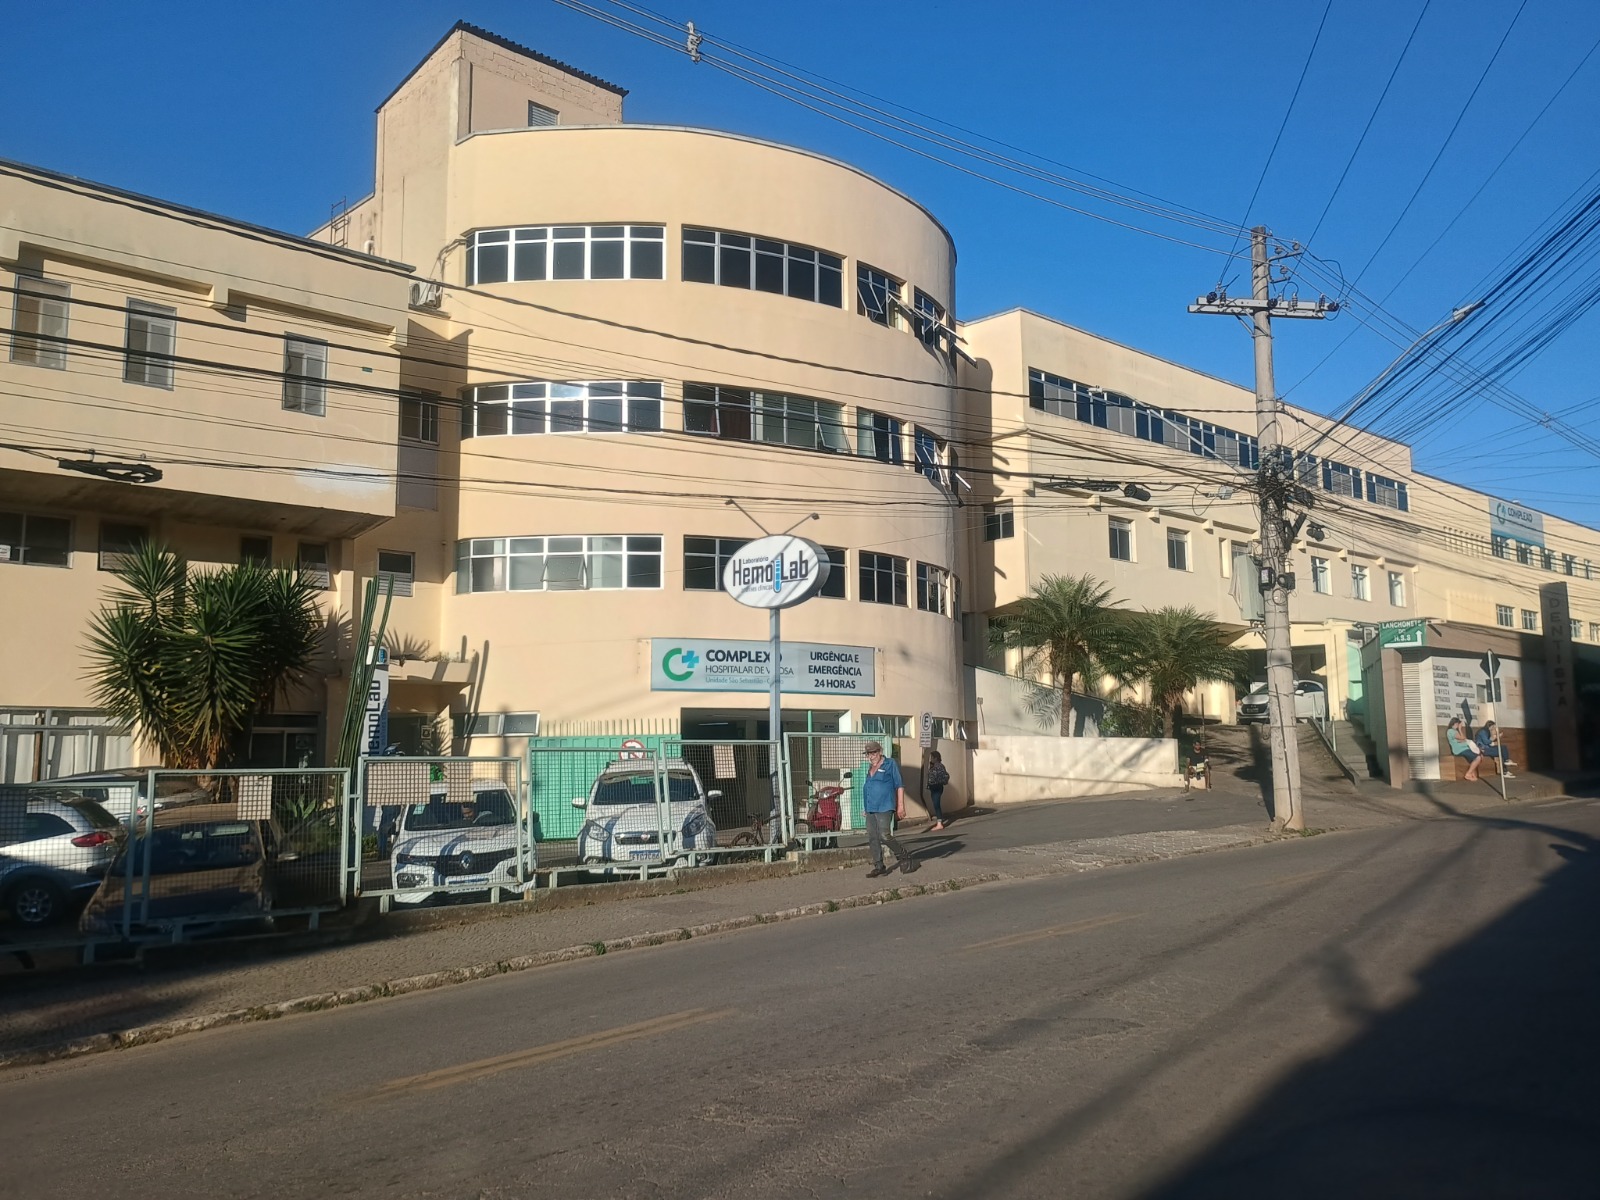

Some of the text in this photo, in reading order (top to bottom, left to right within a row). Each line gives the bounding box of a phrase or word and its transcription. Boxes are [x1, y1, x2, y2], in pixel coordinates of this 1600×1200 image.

[1507, 507, 1533, 523] COMPLEXO
[742, 556, 769, 565] Laboratório
[810, 650, 860, 663] URGÊNCIA E
[1548, 597, 1568, 707] DENTISTA
[705, 665, 795, 675] HOSPITALAR DE VOSA
[808, 664, 863, 676] EMERGÊNCIA
[705, 676, 728, 684] Unidade
[729, 676, 738, 684] São
[814, 678, 856, 689] 24 HORAS
[923, 715, 929, 728] E
